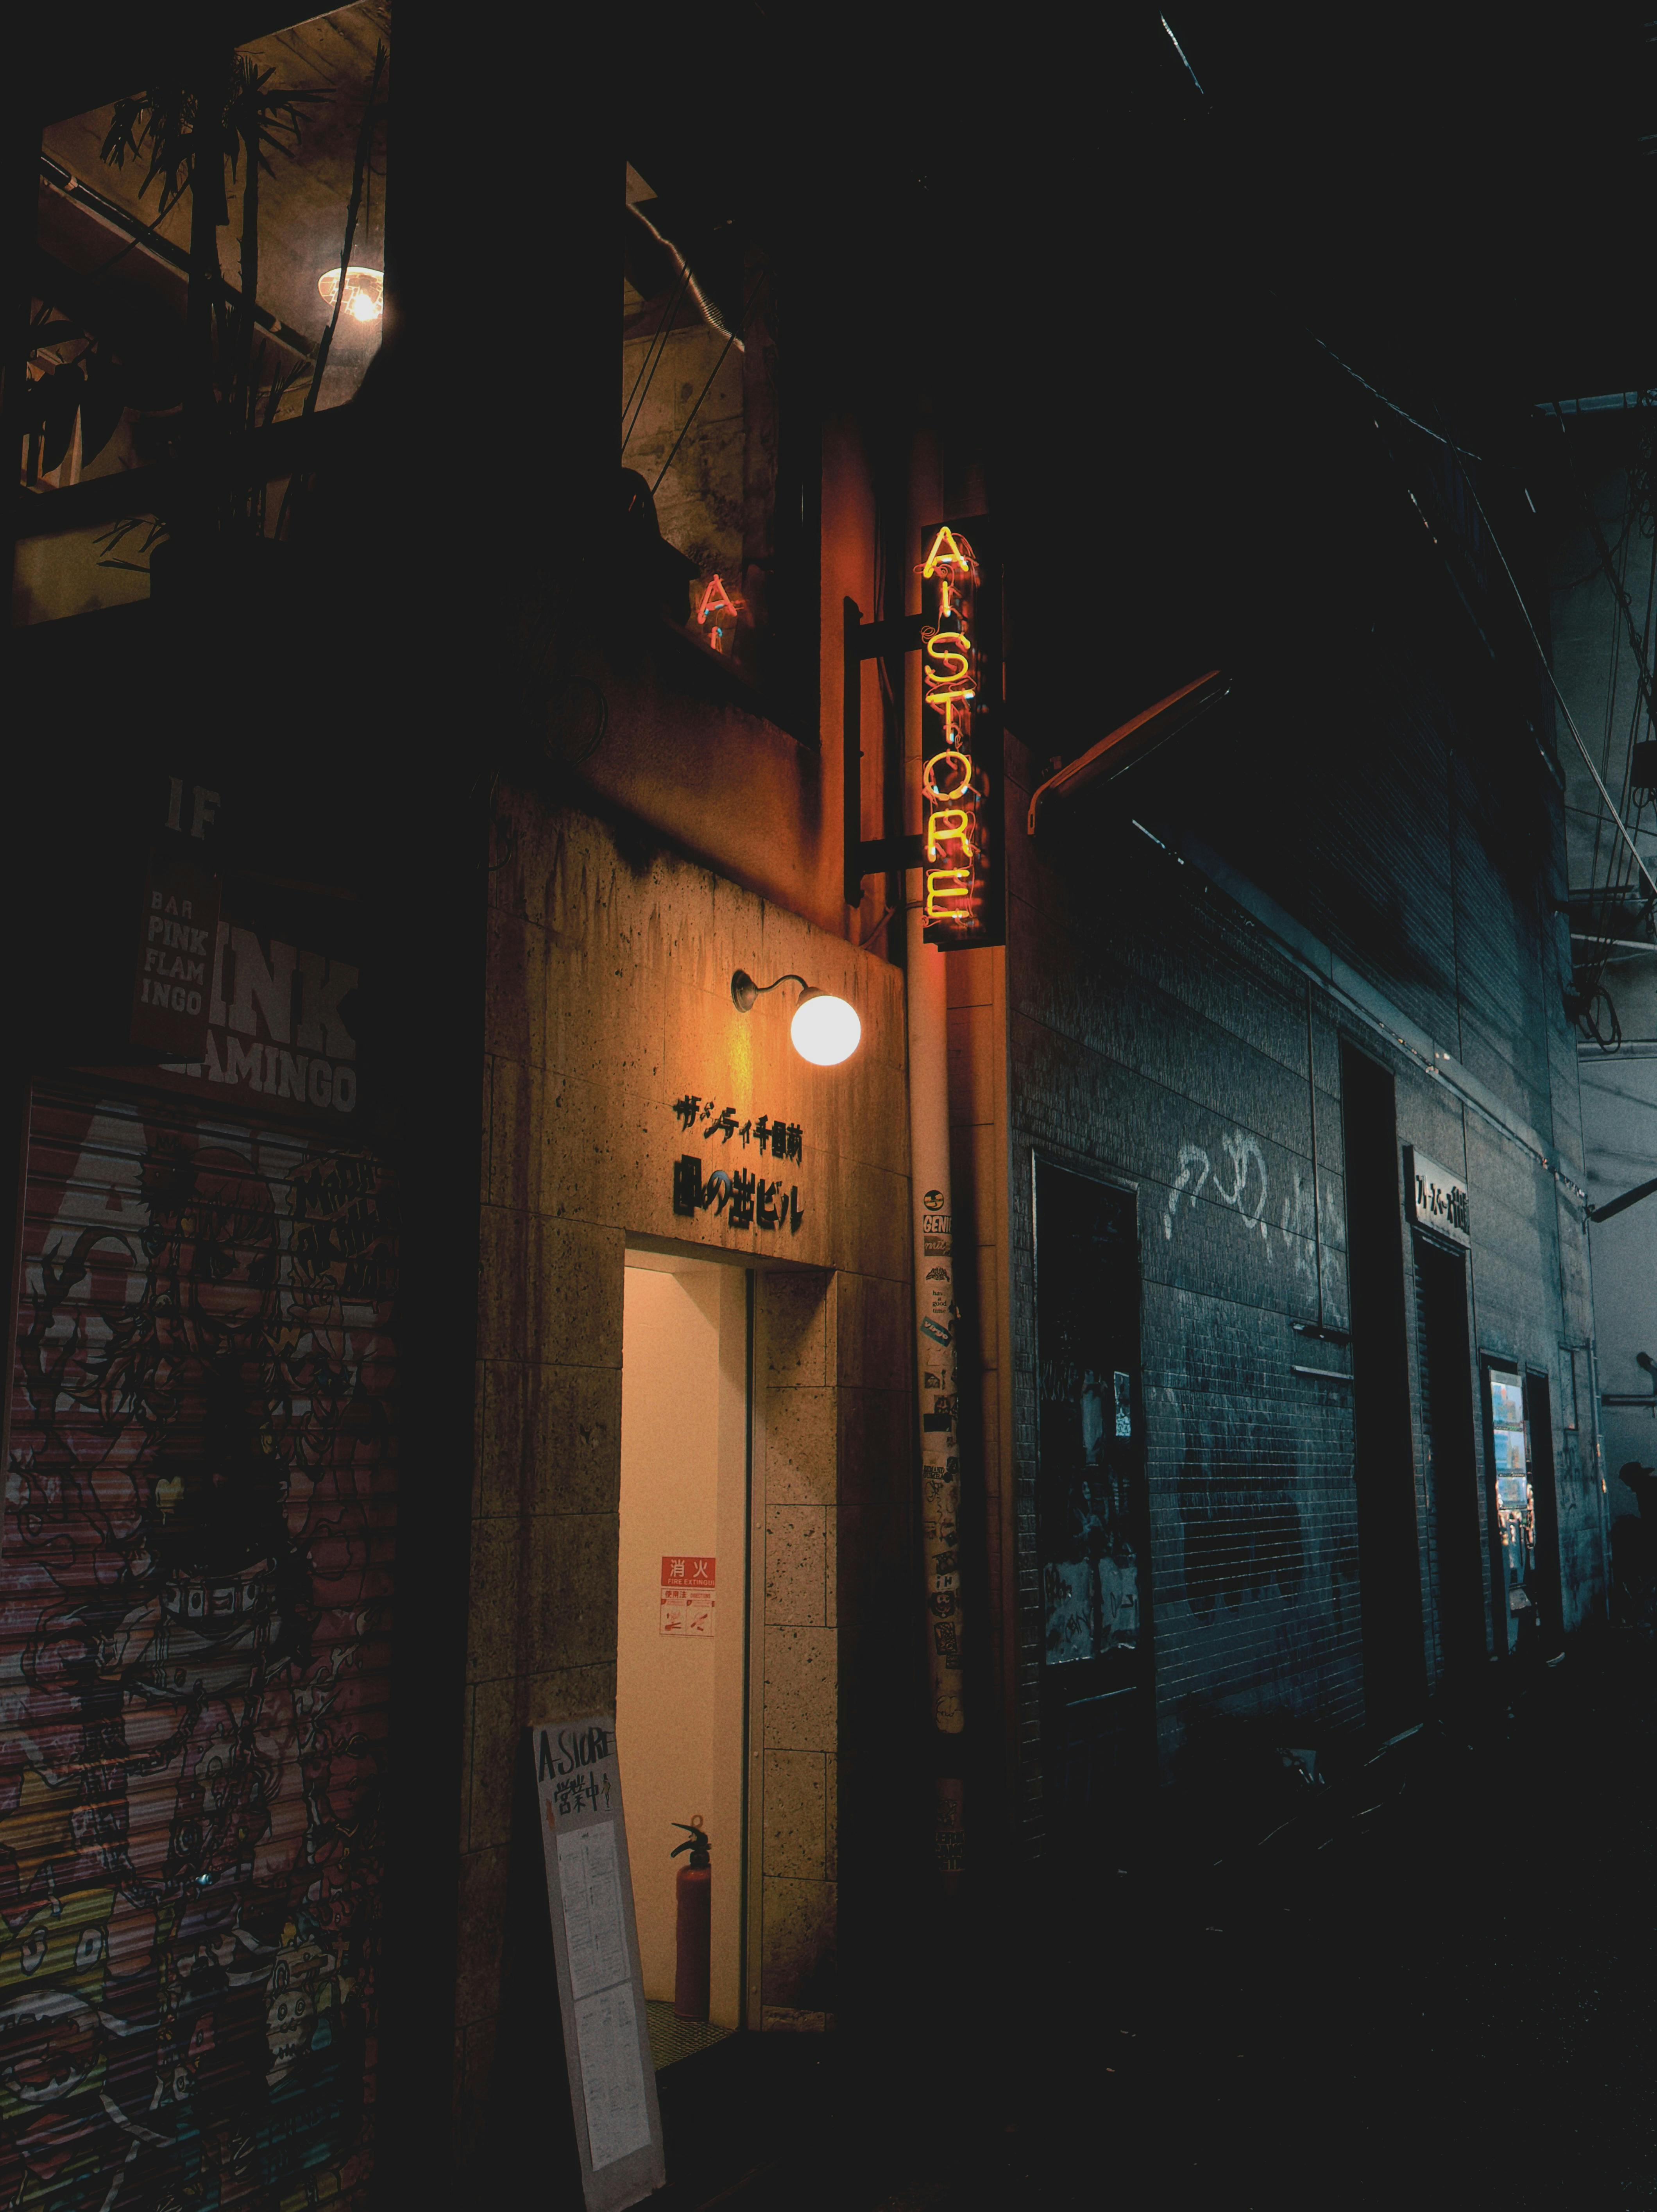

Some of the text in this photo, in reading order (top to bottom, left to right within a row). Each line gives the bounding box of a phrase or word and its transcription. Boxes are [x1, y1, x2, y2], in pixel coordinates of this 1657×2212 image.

[150, 890, 193, 920] BAR
[147, 915, 209, 956] PINK
[143, 947, 206, 986] FLAM
[140, 977, 202, 1016] INGO
[158, 1029, 357, 1113] AMINGO
